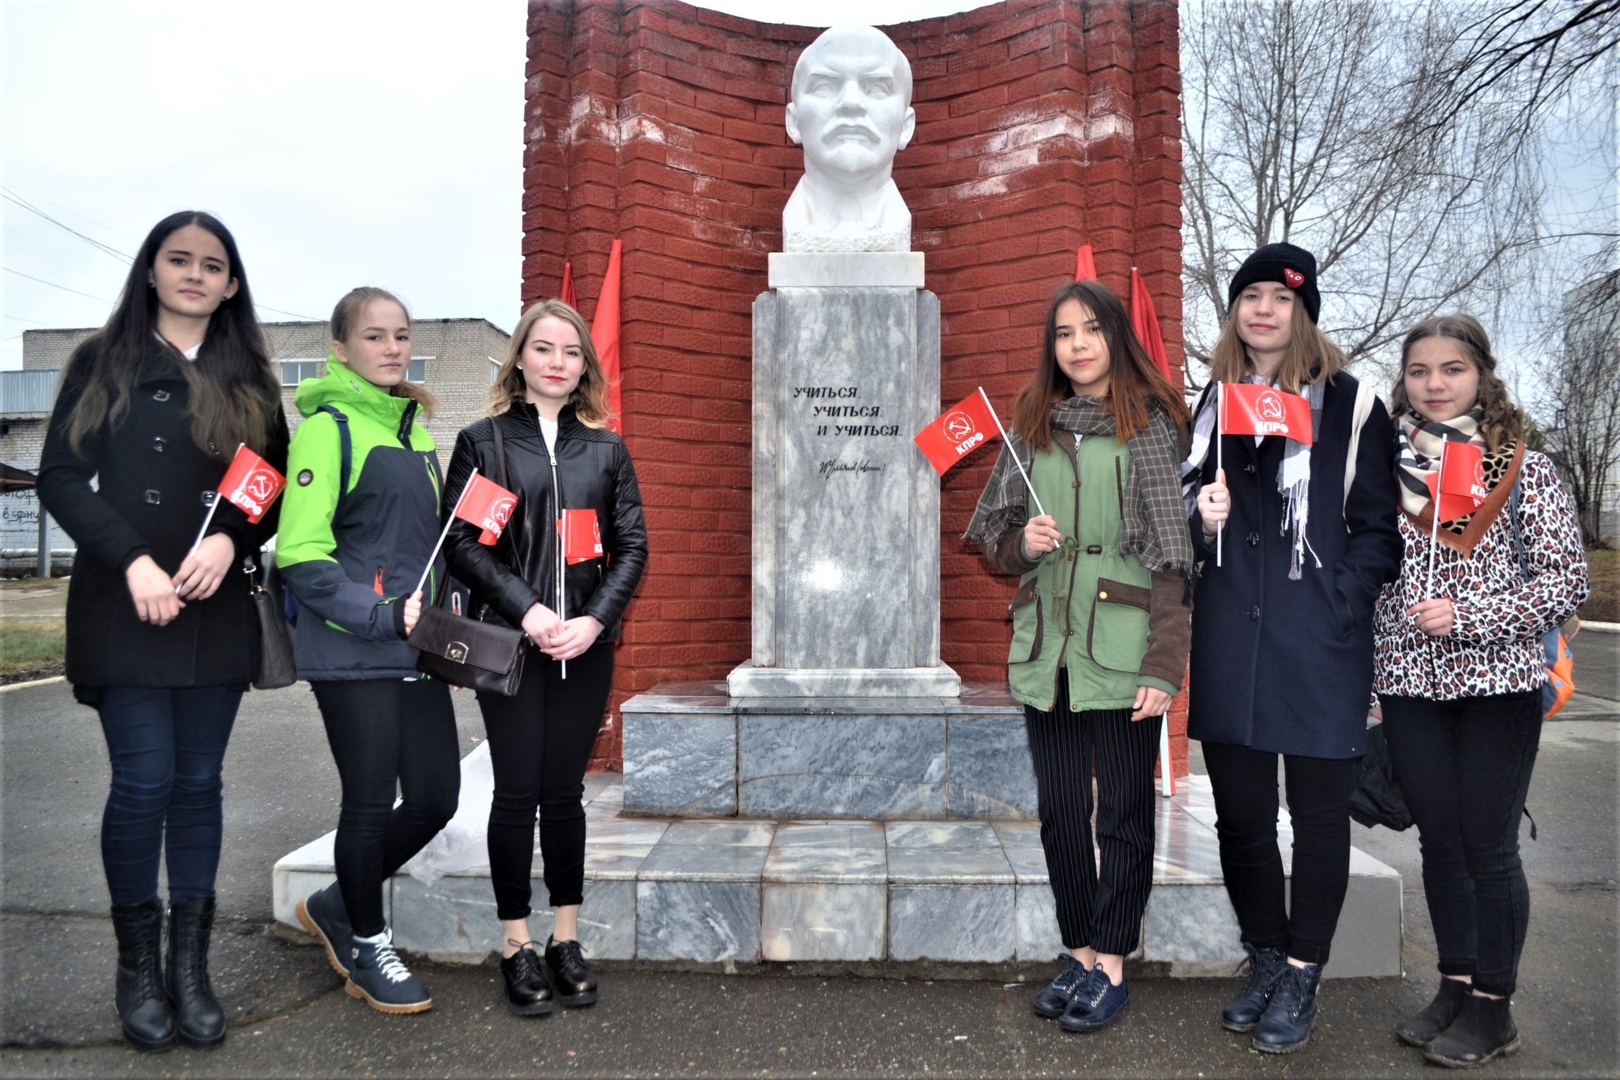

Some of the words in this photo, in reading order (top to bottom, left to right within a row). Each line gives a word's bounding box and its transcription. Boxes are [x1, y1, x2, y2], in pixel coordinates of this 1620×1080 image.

[817, 425, 828, 436] И
[1255, 421, 1289, 434] КПРФ
[955, 432, 984, 455] КПРФ
[1470, 484, 1486, 497] КП
[230, 487, 263, 515] КПРФ
